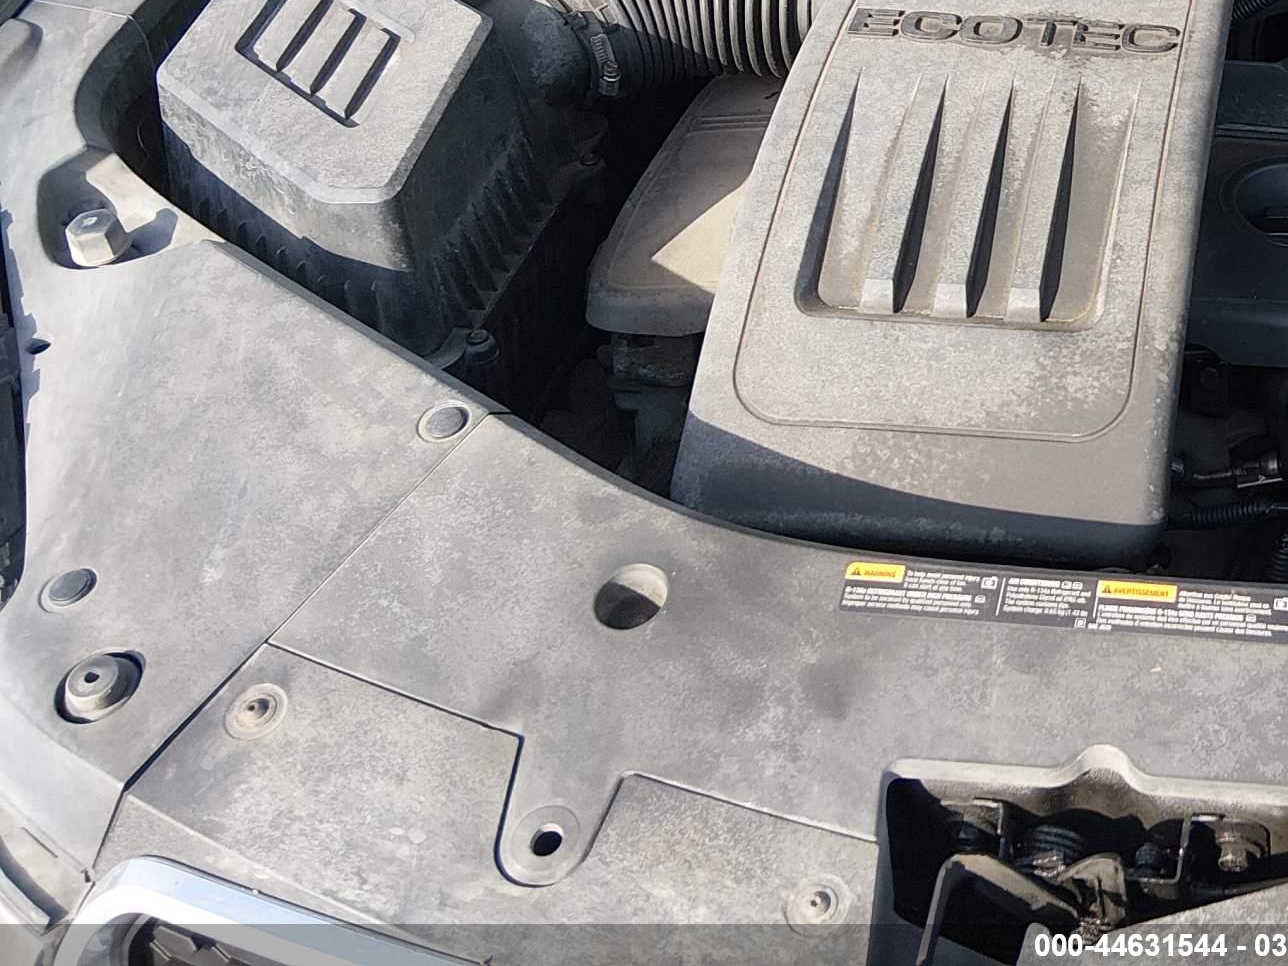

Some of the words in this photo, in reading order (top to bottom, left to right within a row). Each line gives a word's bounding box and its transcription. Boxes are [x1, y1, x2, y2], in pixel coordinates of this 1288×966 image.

[847, 7, 1181, 53] ECOTEC
[863, 569, 897, 578] WARNING
[1113, 587, 1169, 598] AVERTISSEMENT
